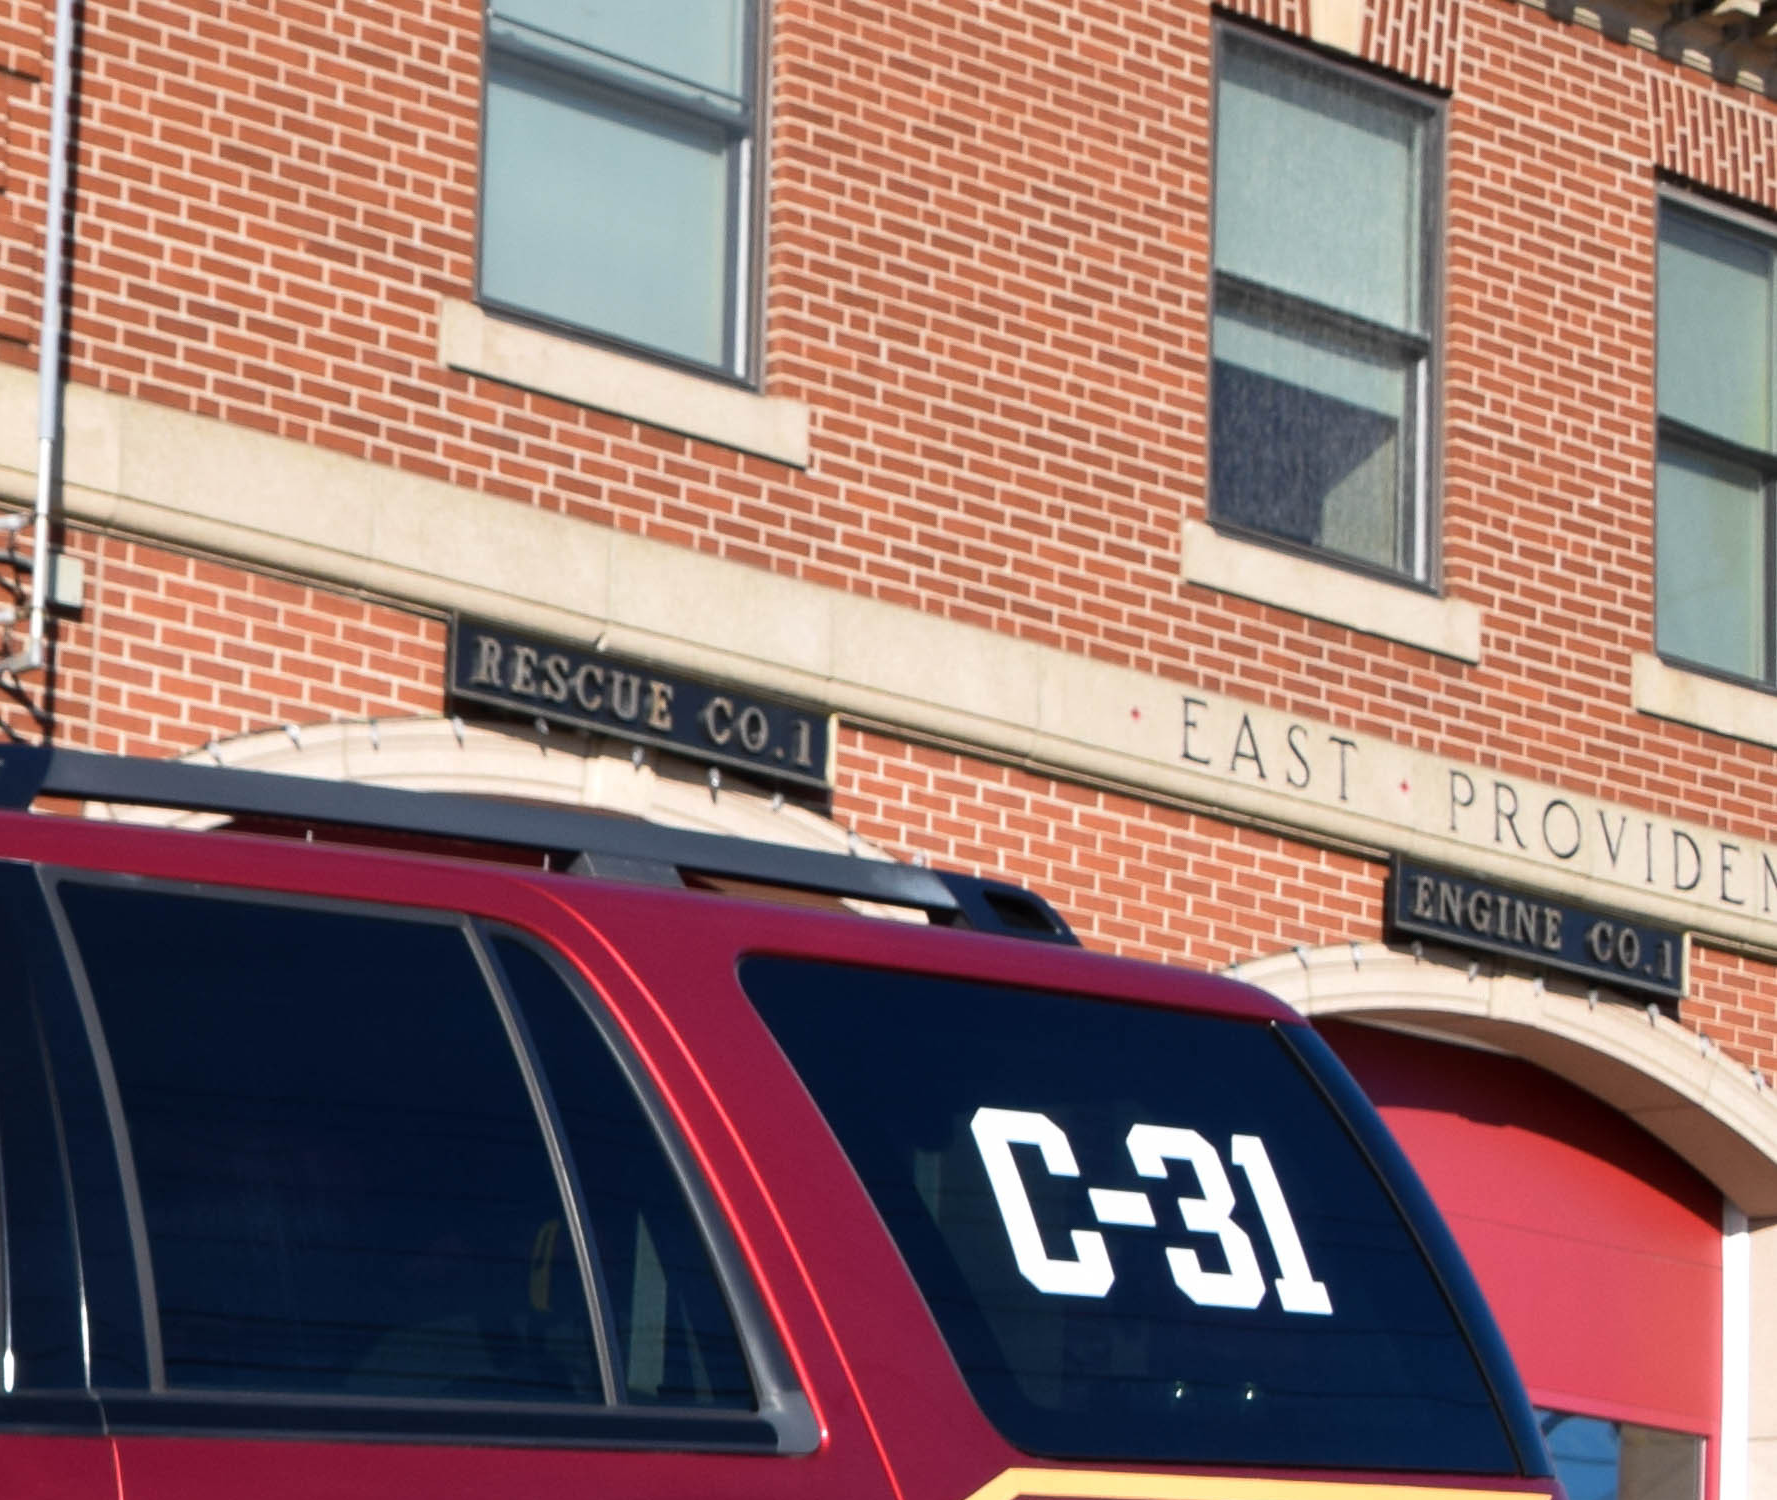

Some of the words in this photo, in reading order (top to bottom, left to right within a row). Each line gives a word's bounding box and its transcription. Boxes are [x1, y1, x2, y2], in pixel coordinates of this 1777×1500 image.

[470, 634, 674, 732] RESCUE
[1182, 697, 1358, 802] EAST
[1412, 875, 1563, 952] ENGINE
[970, 1107, 1333, 1315] C-31
